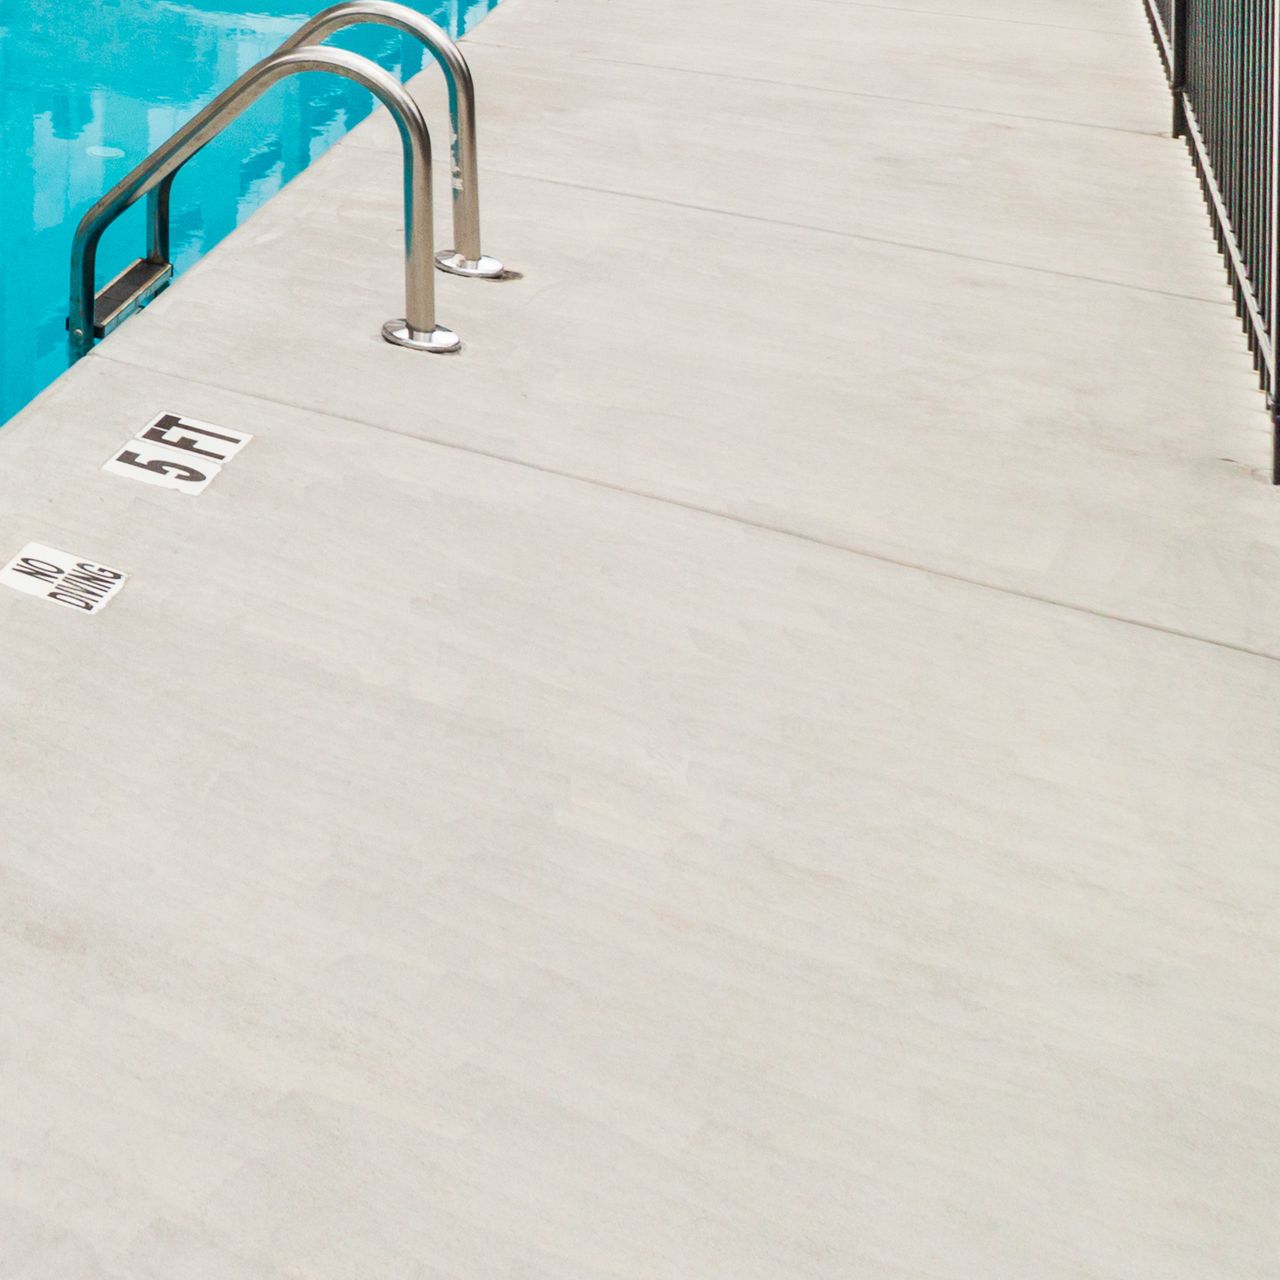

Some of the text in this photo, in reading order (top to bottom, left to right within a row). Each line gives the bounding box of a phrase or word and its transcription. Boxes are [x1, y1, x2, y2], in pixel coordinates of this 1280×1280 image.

[116, 414, 242, 482] 5 FT
[11, 557, 65, 584] NO
[47, 562, 123, 611] DIVING
